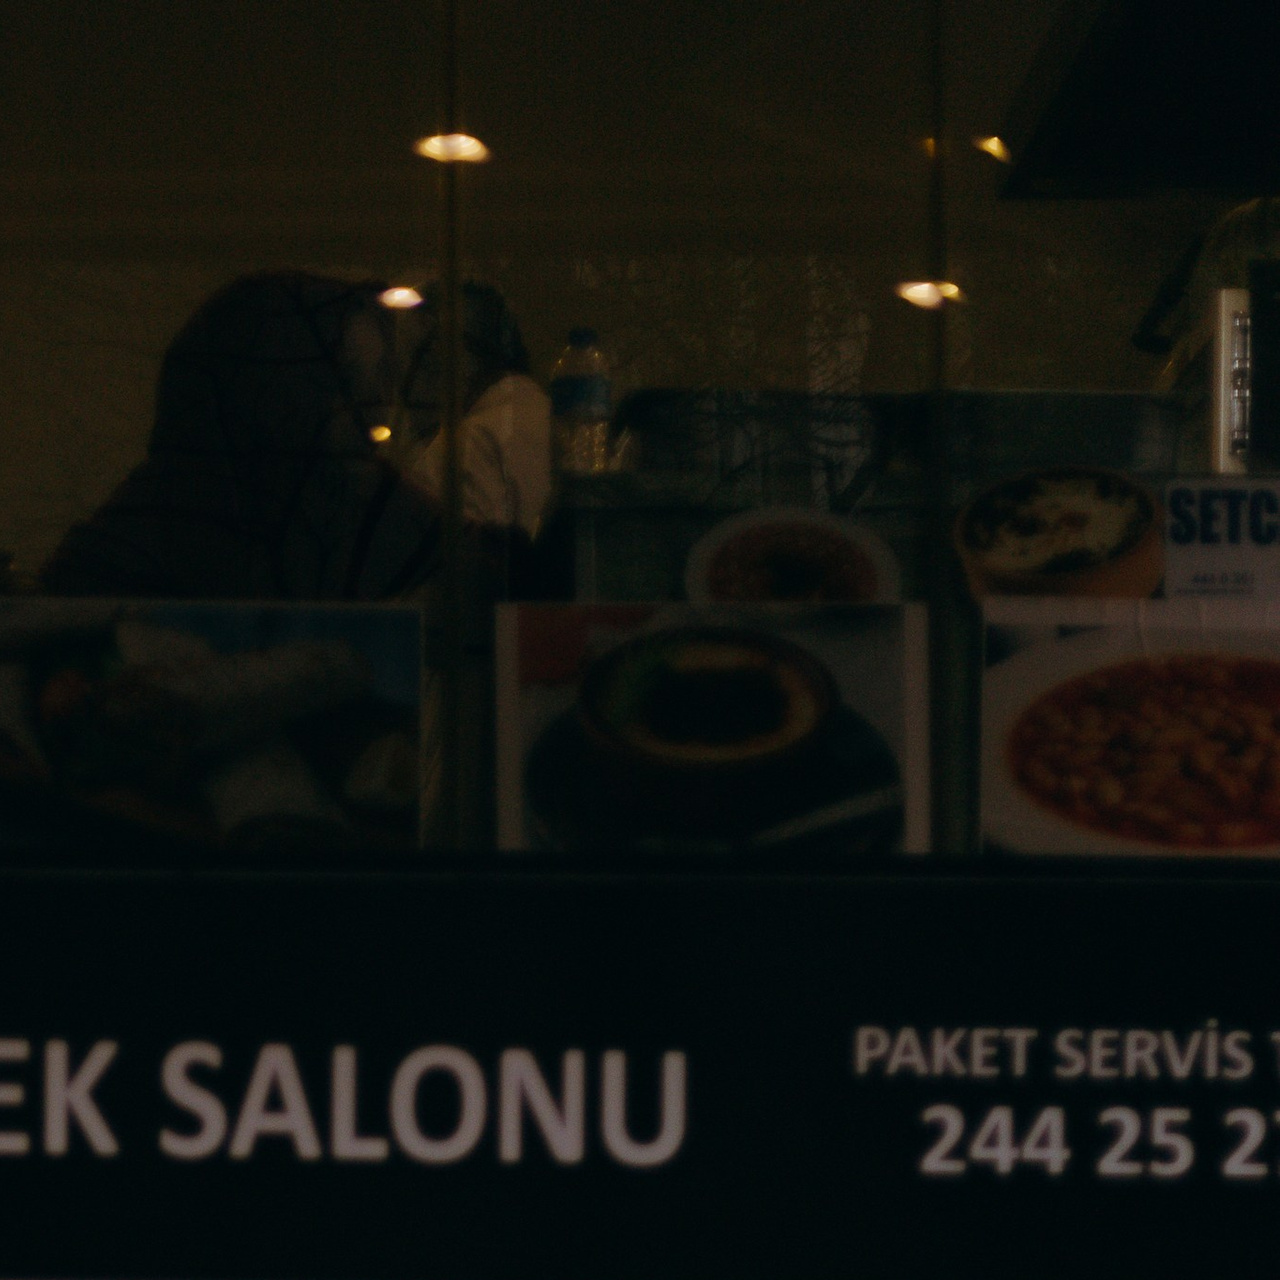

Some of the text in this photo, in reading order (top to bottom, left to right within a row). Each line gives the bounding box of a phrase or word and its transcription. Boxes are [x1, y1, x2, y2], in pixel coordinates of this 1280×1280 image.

[854, 1026, 1038, 1077] PAKET
[158, 1039, 688, 1168] SALONU
[920, 1105, 1072, 1175] 244
[1097, 1106, 1195, 1177] 25
